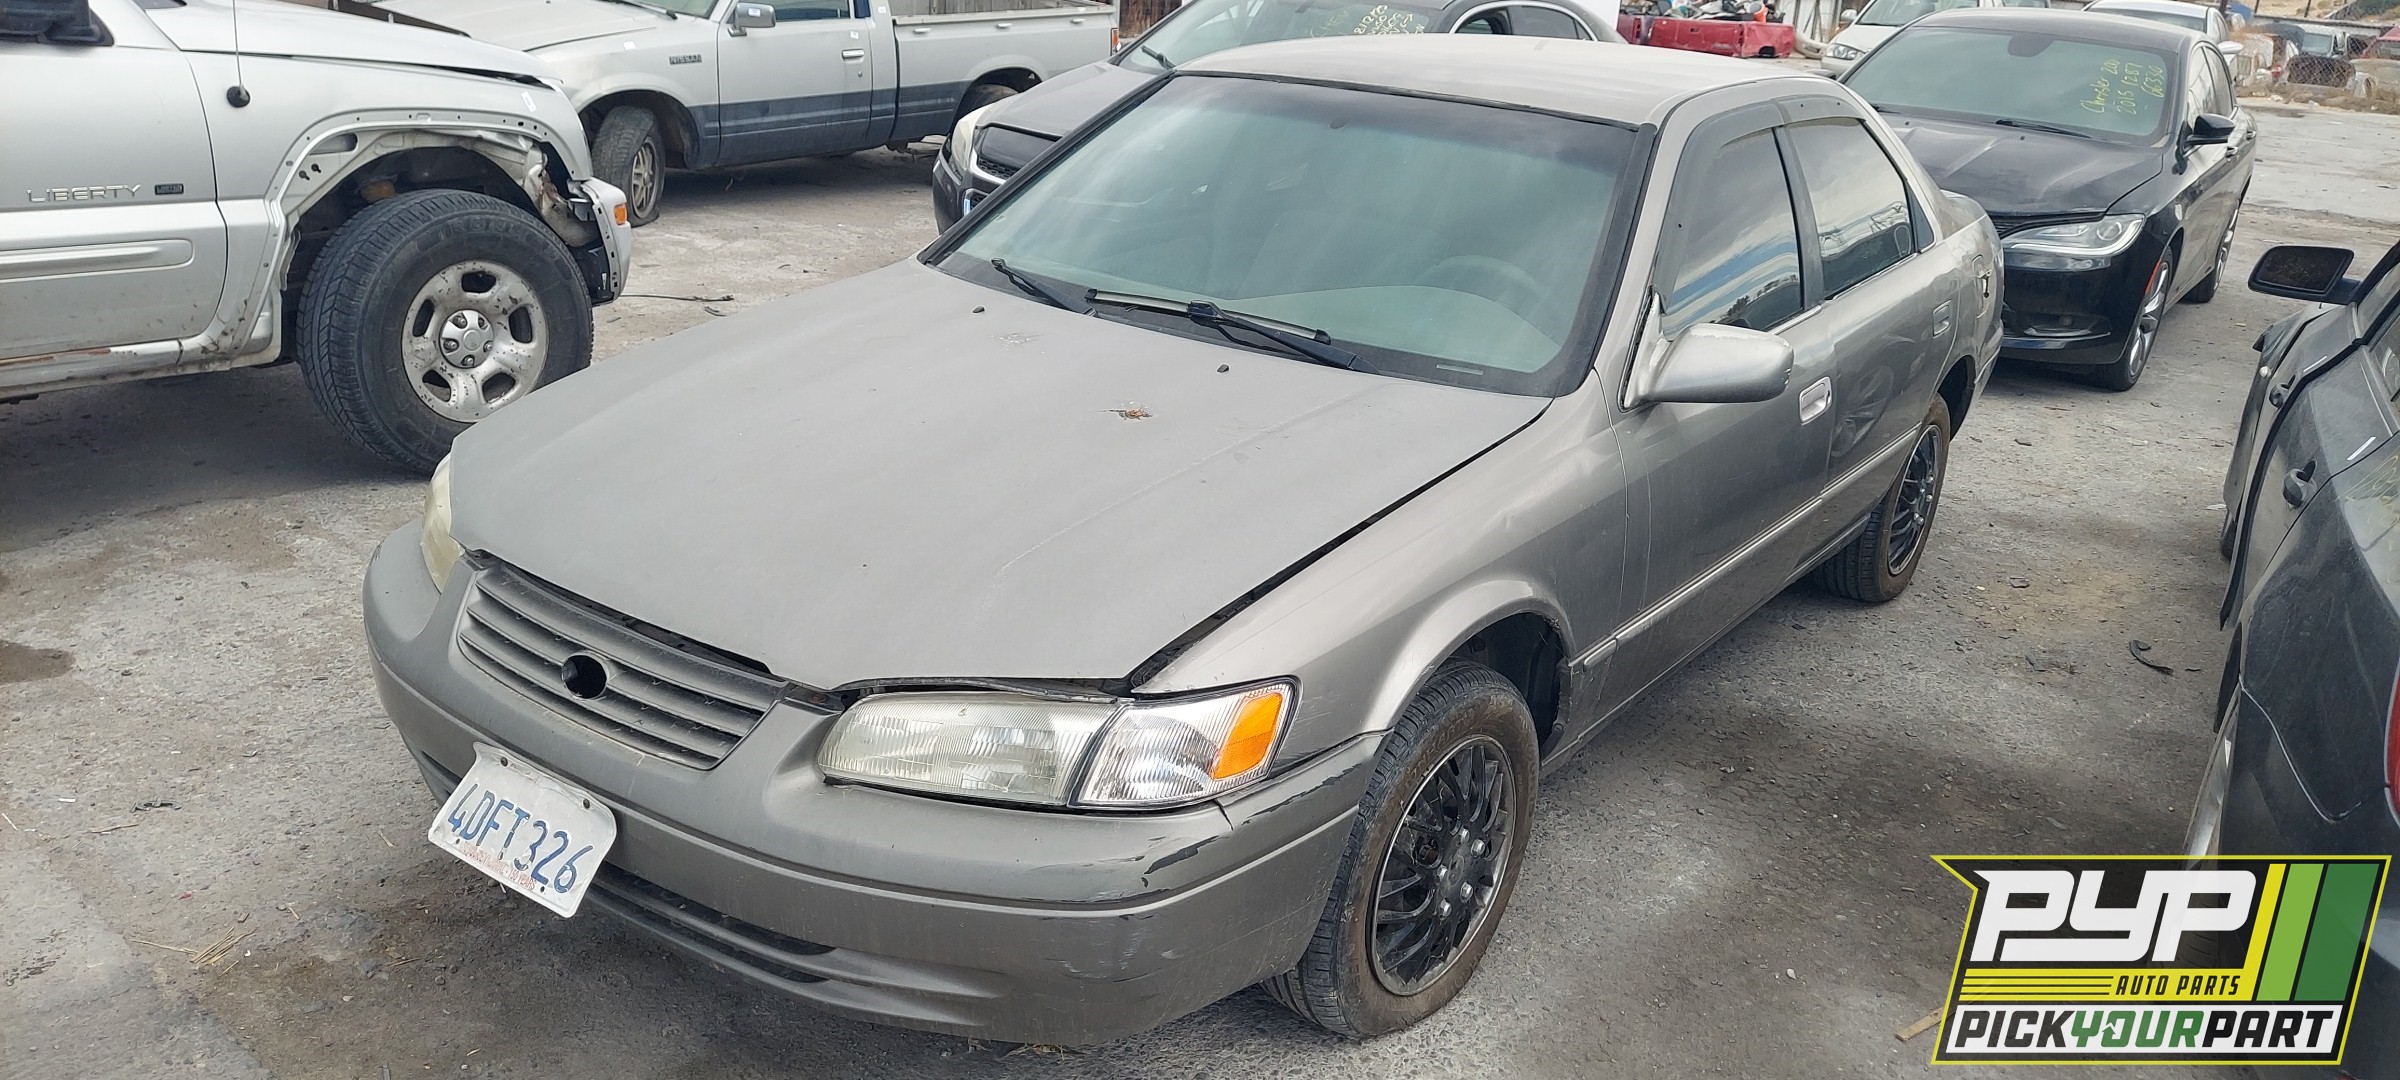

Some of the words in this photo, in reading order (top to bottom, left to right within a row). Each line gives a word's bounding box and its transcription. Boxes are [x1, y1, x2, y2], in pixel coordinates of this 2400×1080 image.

[2116, 89, 2137, 115] 2015
[27, 184, 141, 203] LIBERTY
[448, 783, 594, 894] 4DFT326
